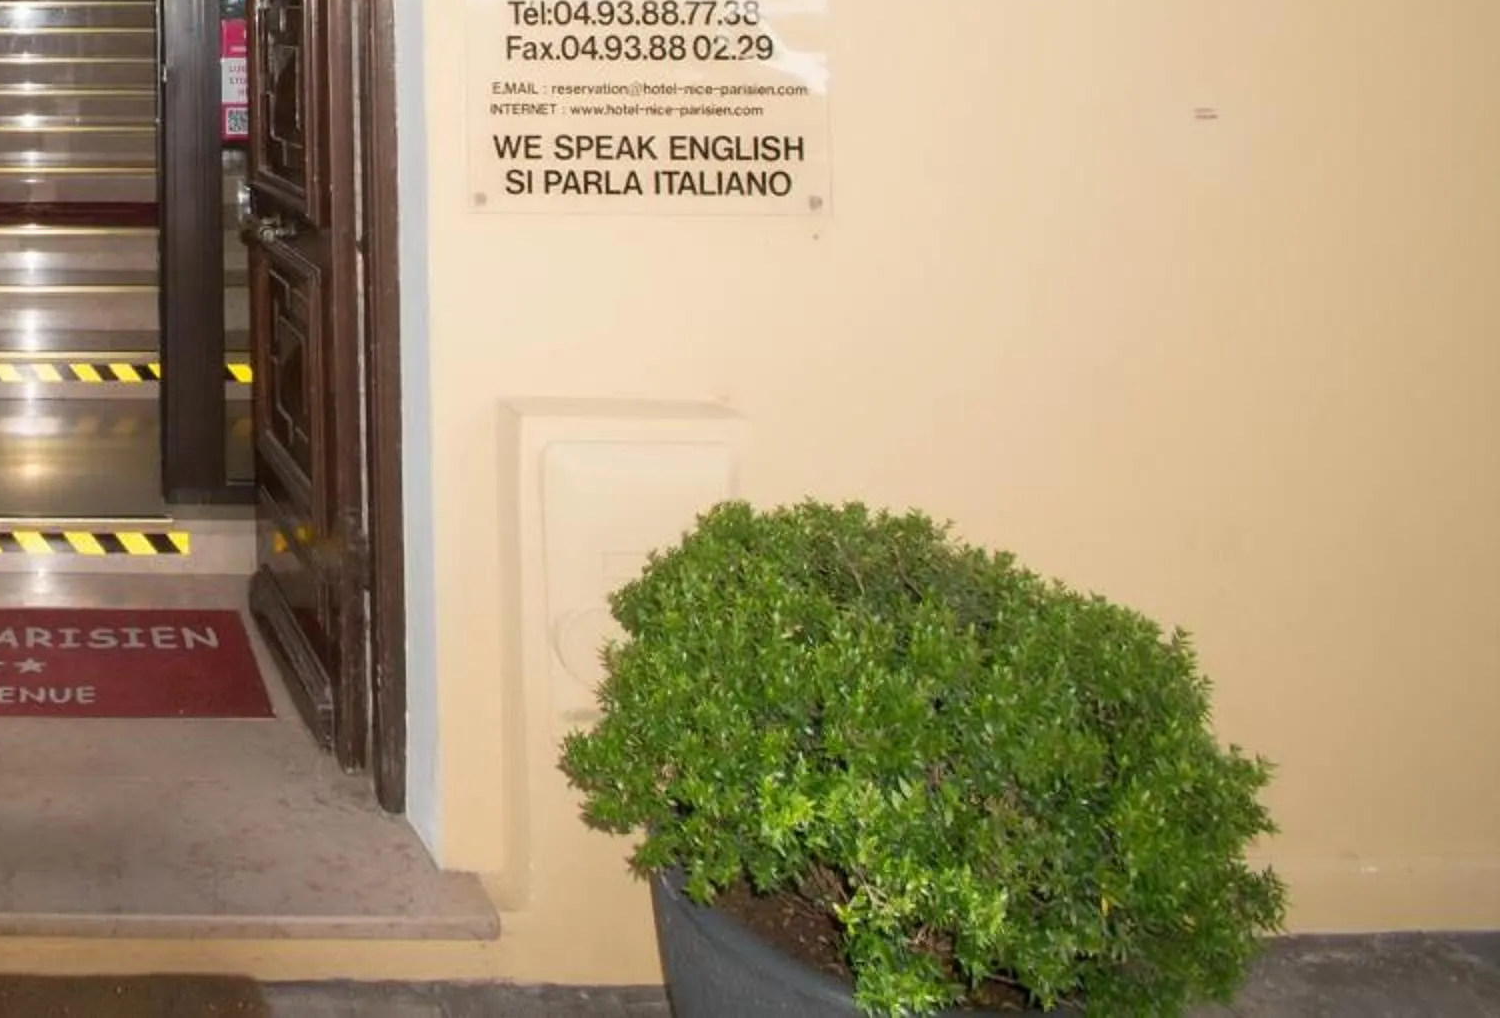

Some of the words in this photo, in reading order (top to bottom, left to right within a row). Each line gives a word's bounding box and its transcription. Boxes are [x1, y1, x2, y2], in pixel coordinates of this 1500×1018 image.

[550, 81, 809, 98] reservation@hotel-nice-parisien.com
[489, 102, 557, 116] INTERNET
[569, 102, 764, 118] www.hotel-nice-parisien.com
[492, 134, 543, 161] WE
[553, 133, 658, 162] SPEAK
[669, 134, 805, 163] ENGLISH
[504, 168, 533, 196] SI
[543, 168, 644, 196] PARLA
[653, 169, 793, 197] ITALIANO
